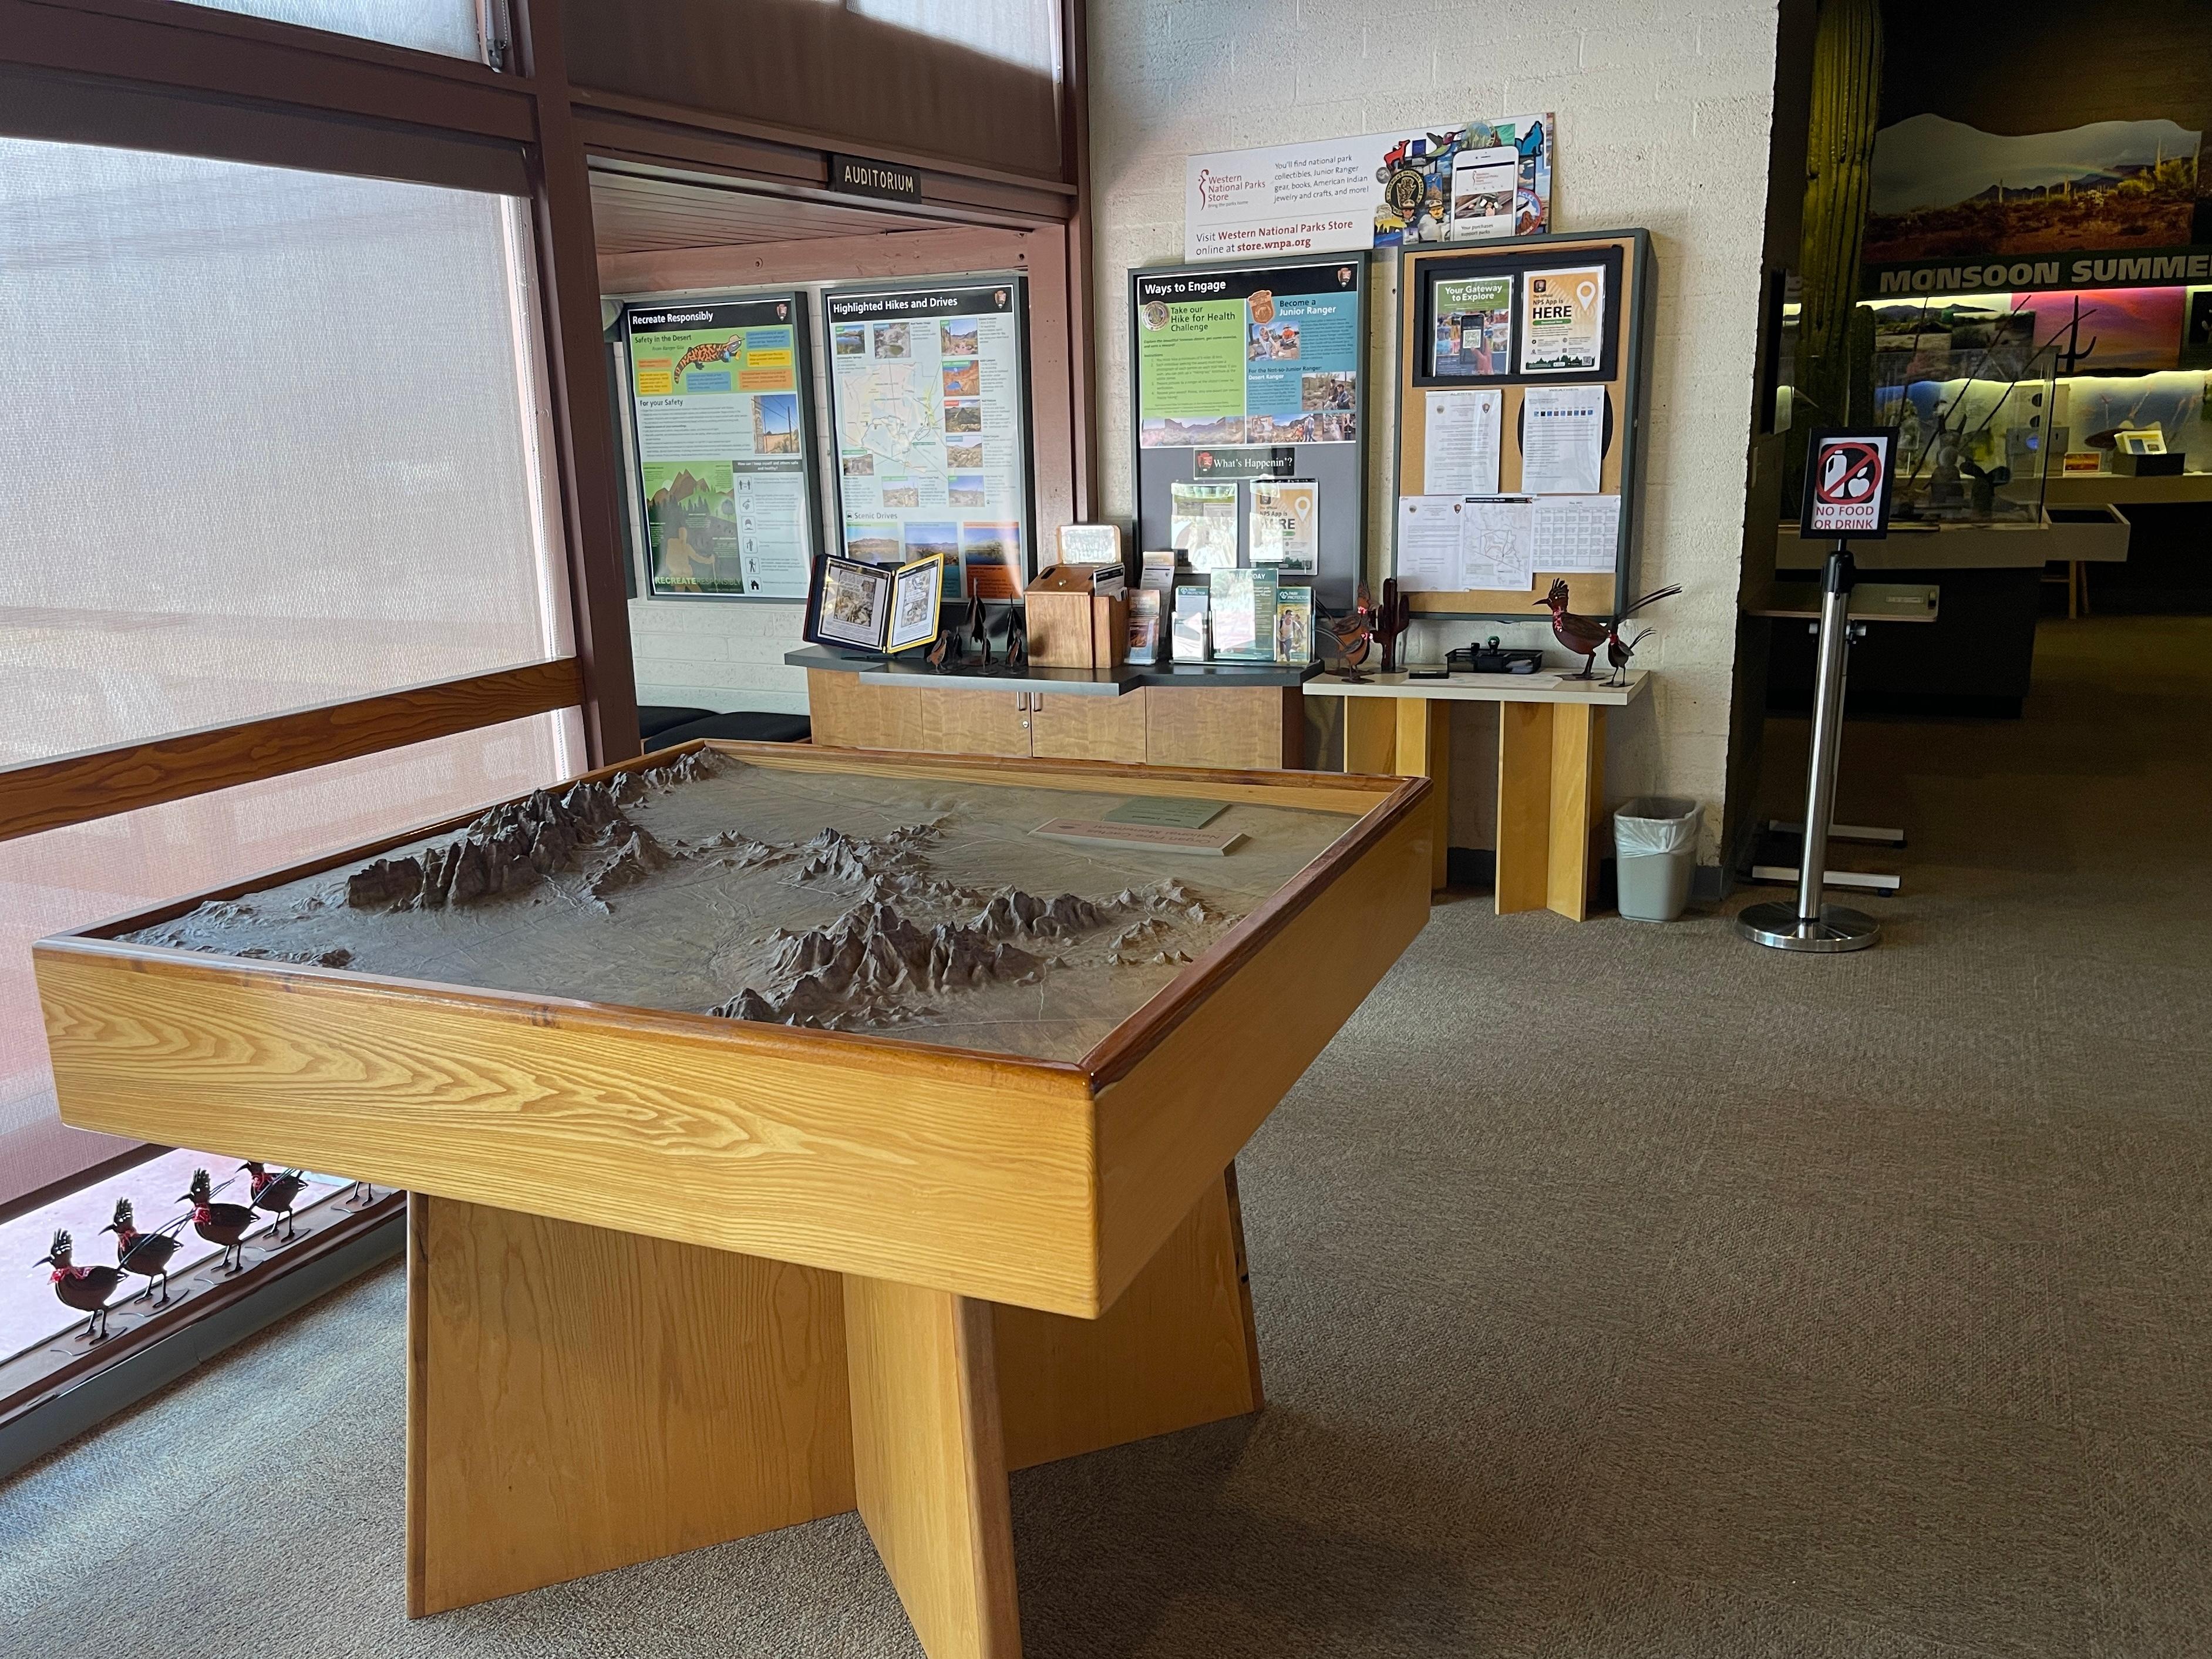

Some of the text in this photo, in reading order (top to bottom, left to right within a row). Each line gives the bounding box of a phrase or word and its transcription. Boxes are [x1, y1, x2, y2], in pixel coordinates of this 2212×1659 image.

[1275, 161, 1292, 169] You'll
[1308, 156, 1336, 166] national
[1338, 154, 1352, 164] park
[844, 165, 914, 193] AUDITORIUM
[1275, 165, 1359, 180] collectibles, Junior Ranger
[1208, 175, 1242, 184] Western
[1274, 175, 1368, 193] gear, books, American Indian
[1208, 180, 1265, 193] National Parks
[1208, 194, 1229, 202] Store
[1274, 194, 1298, 204] jewelry
[1299, 191, 1312, 200] and
[1313, 190, 1333, 198] crafts,
[1335, 187, 1348, 196] and
[1196, 220, 1353, 243] Visit Western National Parks Store
[1196, 237, 1311, 256] online at store.wnpa.org
[1879, 254, 2212, 293] MONSOON SUMME
[1145, 280, 1226, 295] Ways to Engage
[1445, 285, 1503, 295] Your Gateway
[1462, 293, 1494, 302] Explore
[833, 297, 958, 315] Highlighted Hikes and Drives
[1279, 306, 1336, 317] Junior Ranger
[1533, 305, 1572, 319] HERE
[632, 311, 713, 324] Recreate Responsibly
[1171, 315, 1190, 324] Hike
[1207, 312, 1235, 321] Health
[1171, 323, 1208, 333] Challenge
[635, 336, 652, 344] Safety
[1213, 457, 1292, 469] What's Happenin'?
[854, 512, 875, 520] Scenic
[1816, 506, 1874, 516] NO FOOD
[1814, 519, 1874, 529] OR DRINK
[1087, 829, 1131, 837] Cactus
[1093, 825, 1221, 839] National Monument
